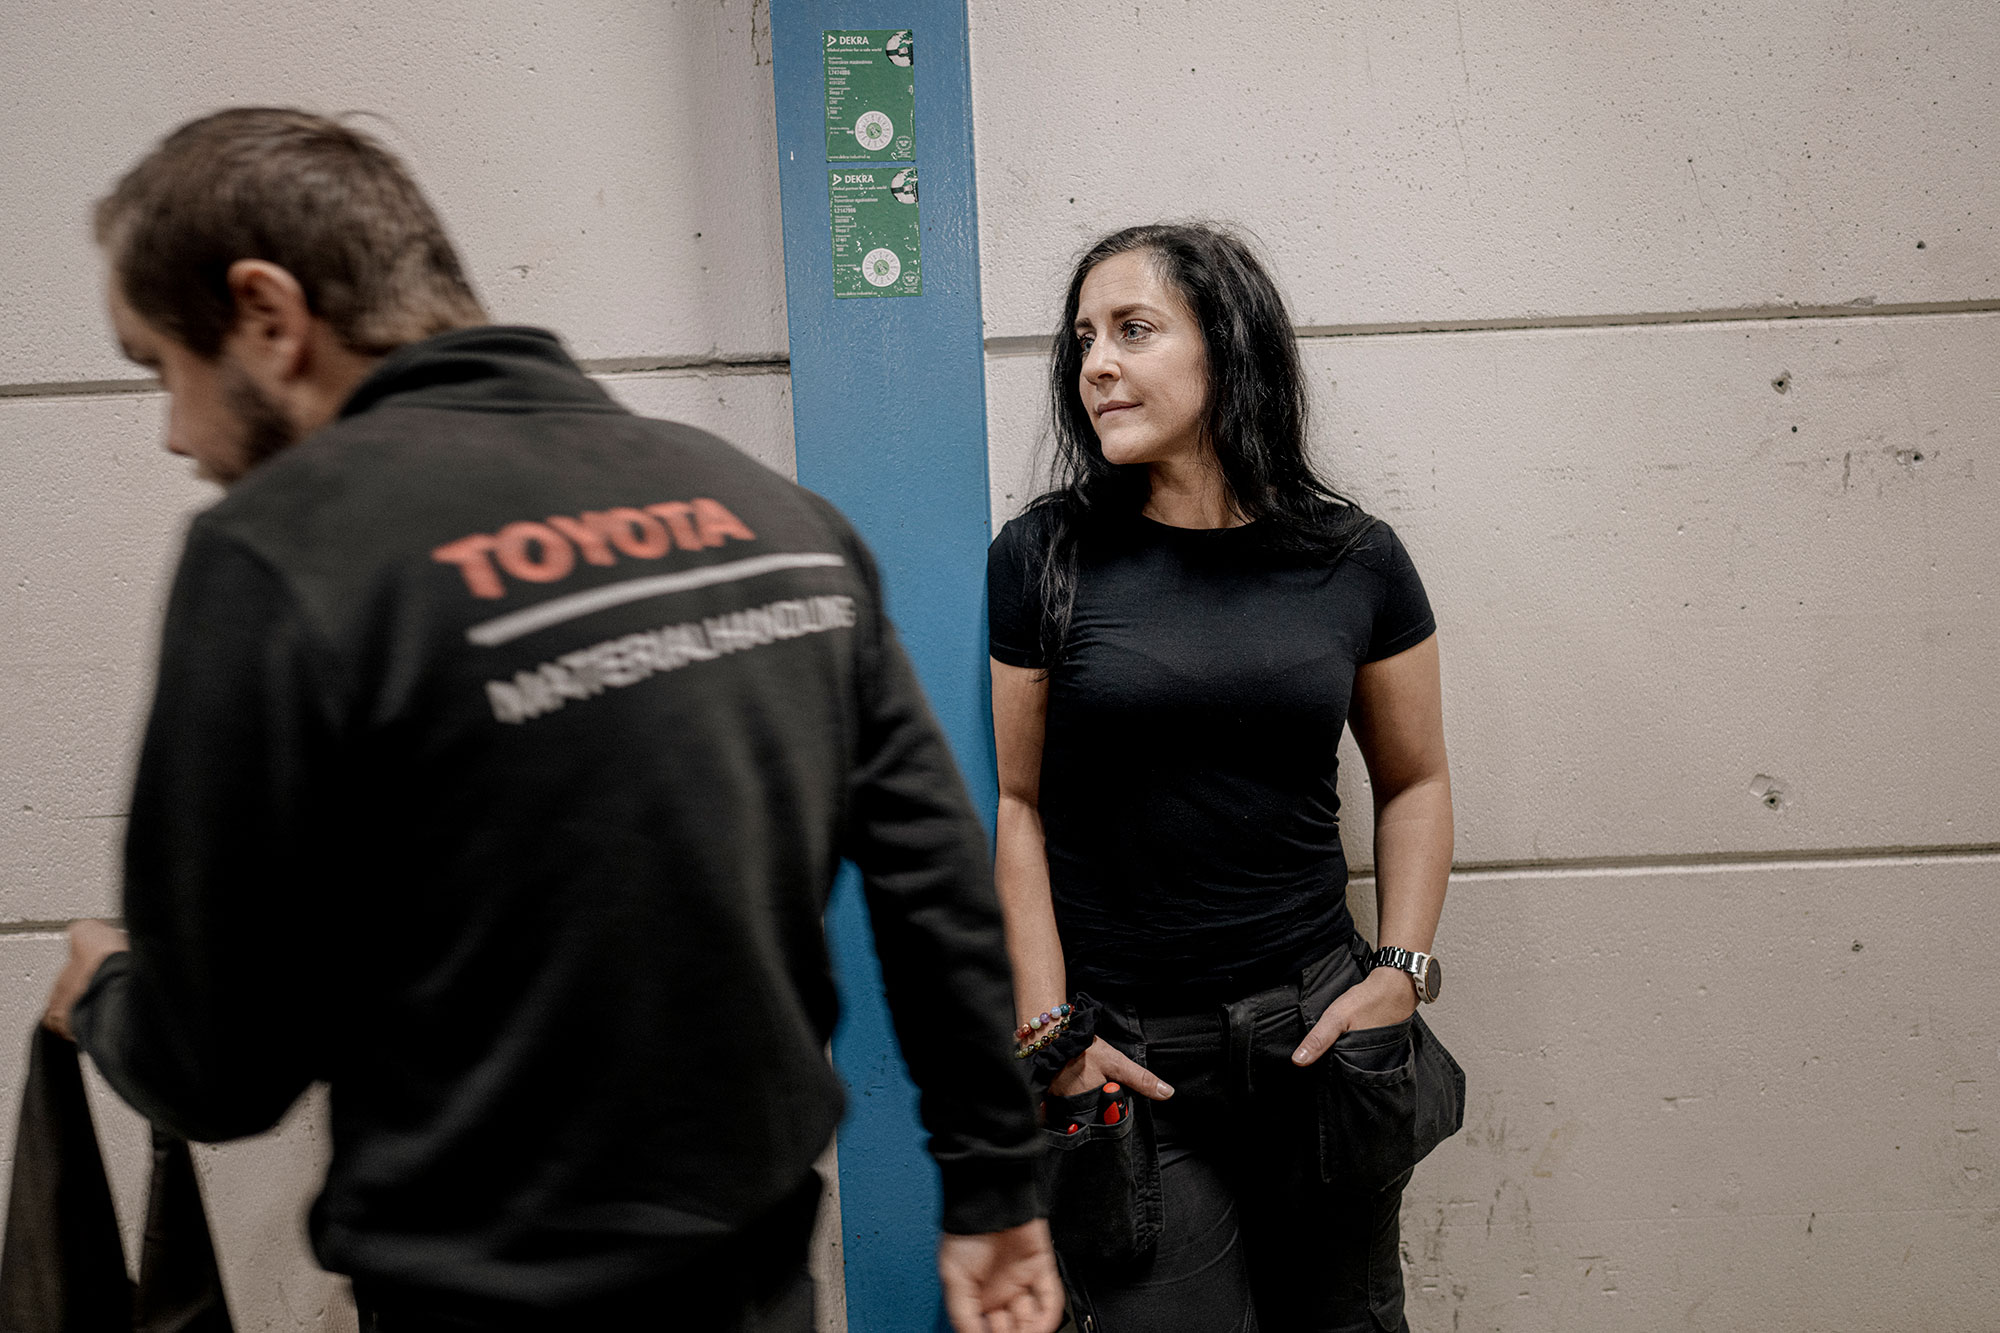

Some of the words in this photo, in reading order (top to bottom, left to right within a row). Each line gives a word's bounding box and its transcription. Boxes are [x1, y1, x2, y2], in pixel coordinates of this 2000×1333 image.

[839, 36, 869, 45] DEKRA
[844, 174, 874, 184] DEKRA
[430, 498, 756, 599] TOYOTA
